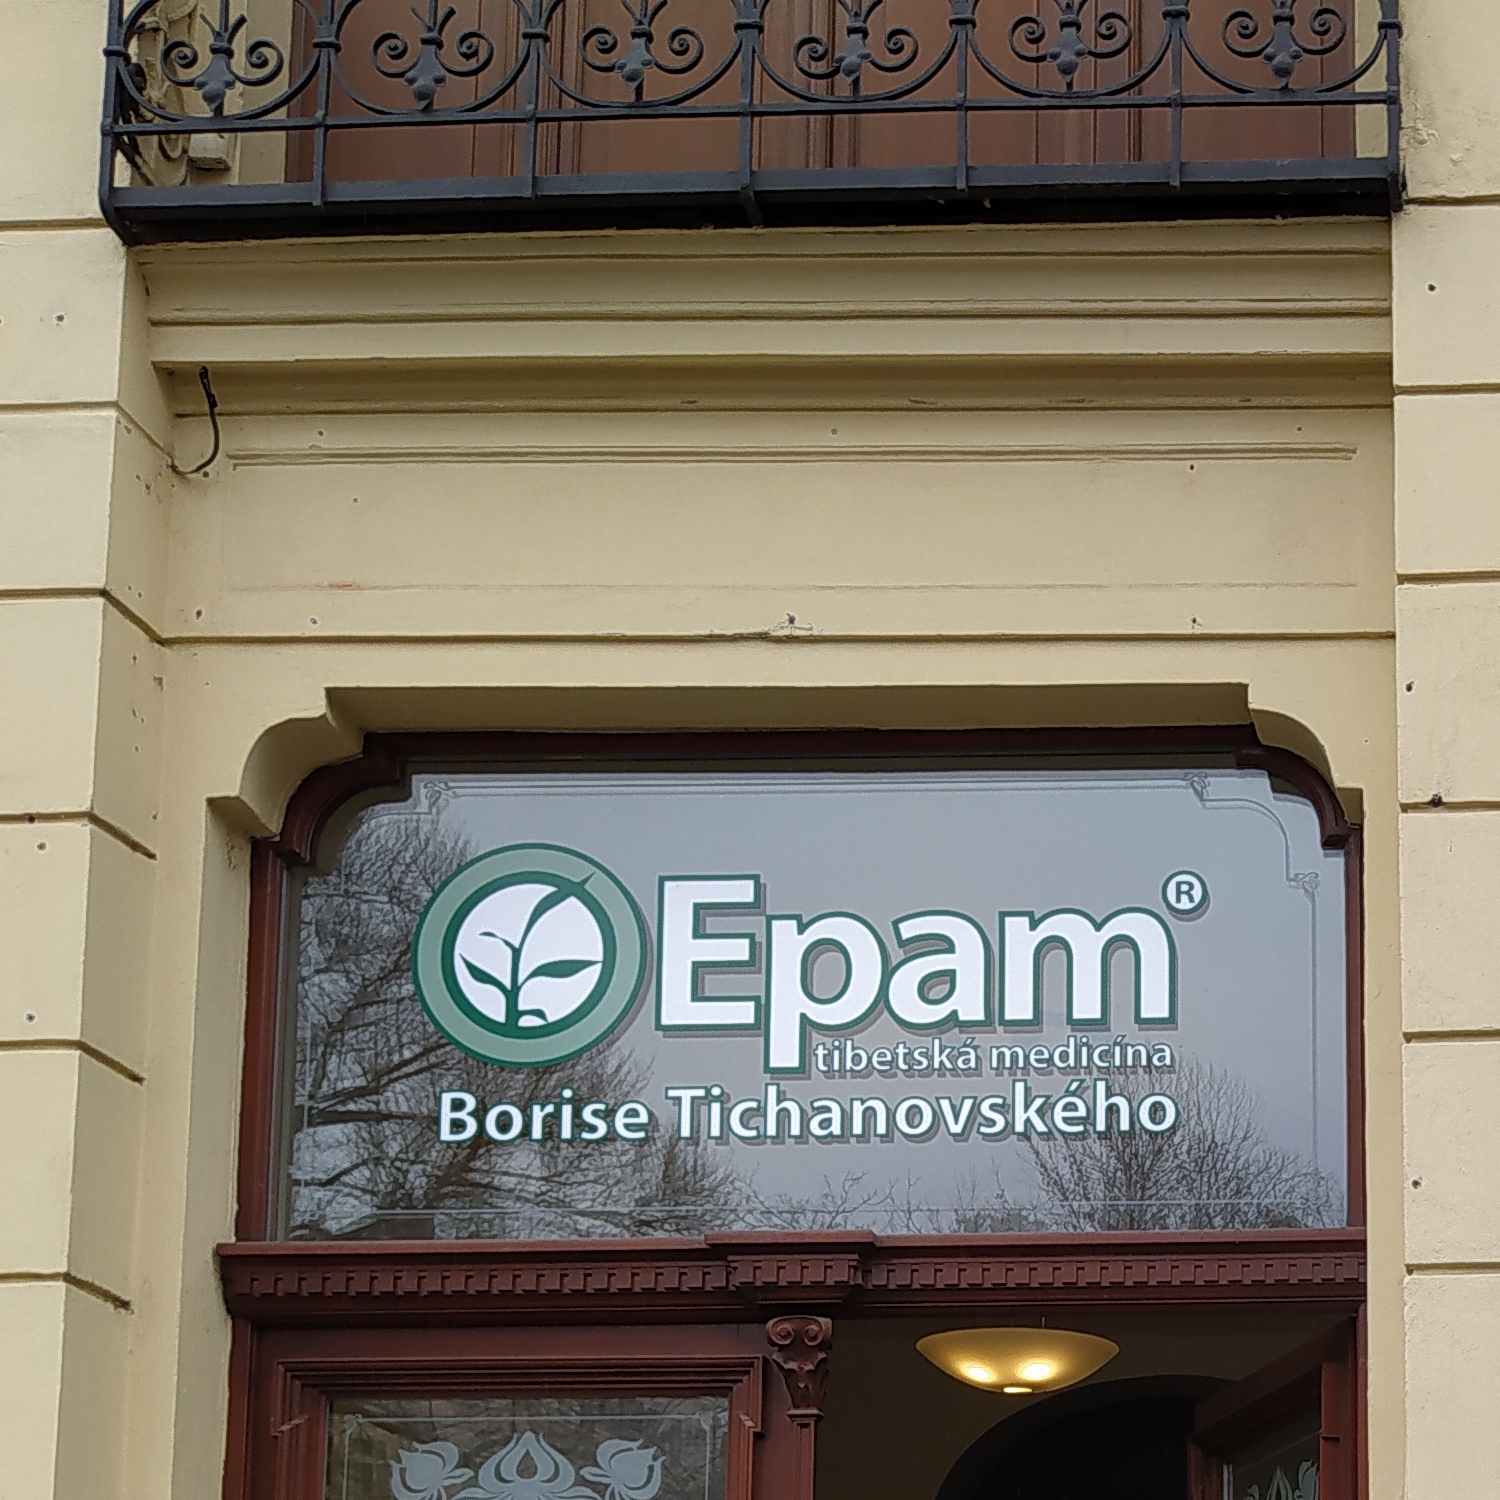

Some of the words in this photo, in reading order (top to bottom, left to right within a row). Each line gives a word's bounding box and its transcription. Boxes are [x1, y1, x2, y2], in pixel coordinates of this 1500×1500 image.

[814, 1037, 979, 1073] tibetská
[988, 1035, 1174, 1071] medicína
[437, 1087, 650, 1143] Borise
[665, 1079, 1180, 1143] Tichanovského
